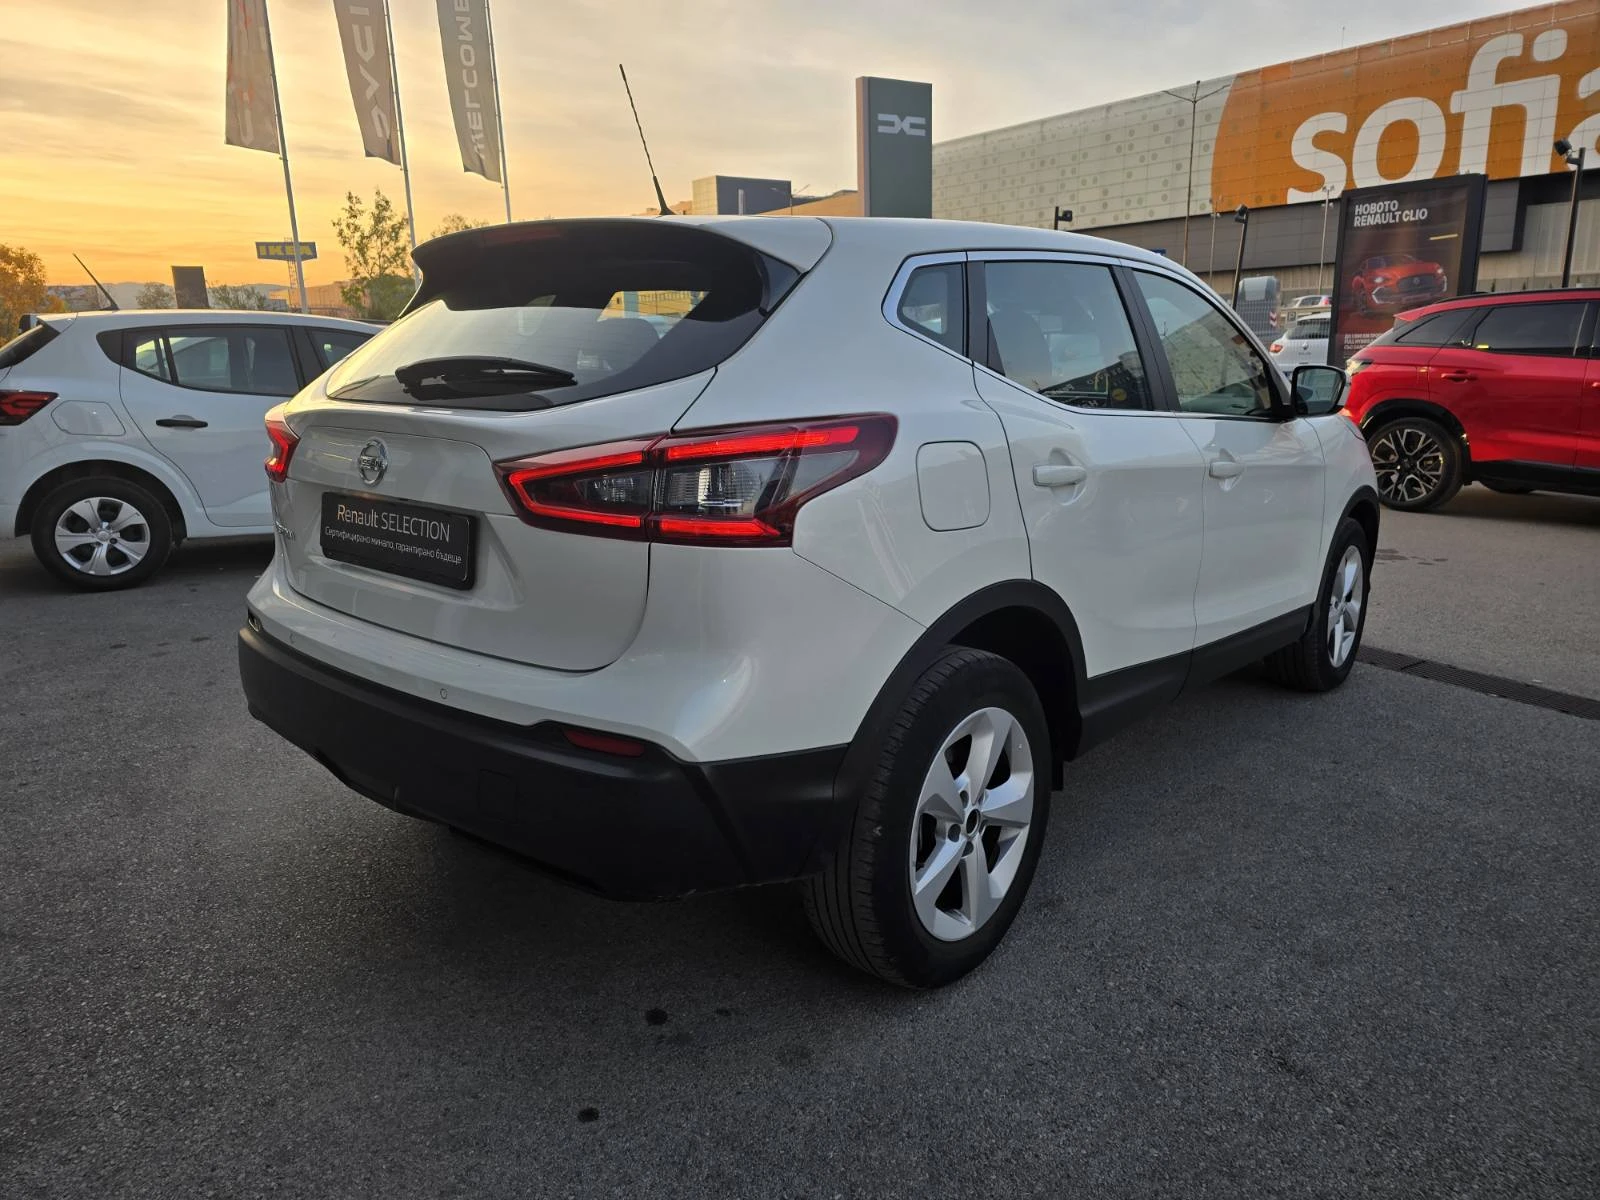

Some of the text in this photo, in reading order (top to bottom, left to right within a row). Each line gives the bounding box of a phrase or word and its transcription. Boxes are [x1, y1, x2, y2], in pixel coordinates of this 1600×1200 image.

[1353, 207, 1428, 227] RENAULT CLIO
[1354, 199, 1399, 216] НОВОТО
[337, 504, 450, 543] Renault SELECTION
